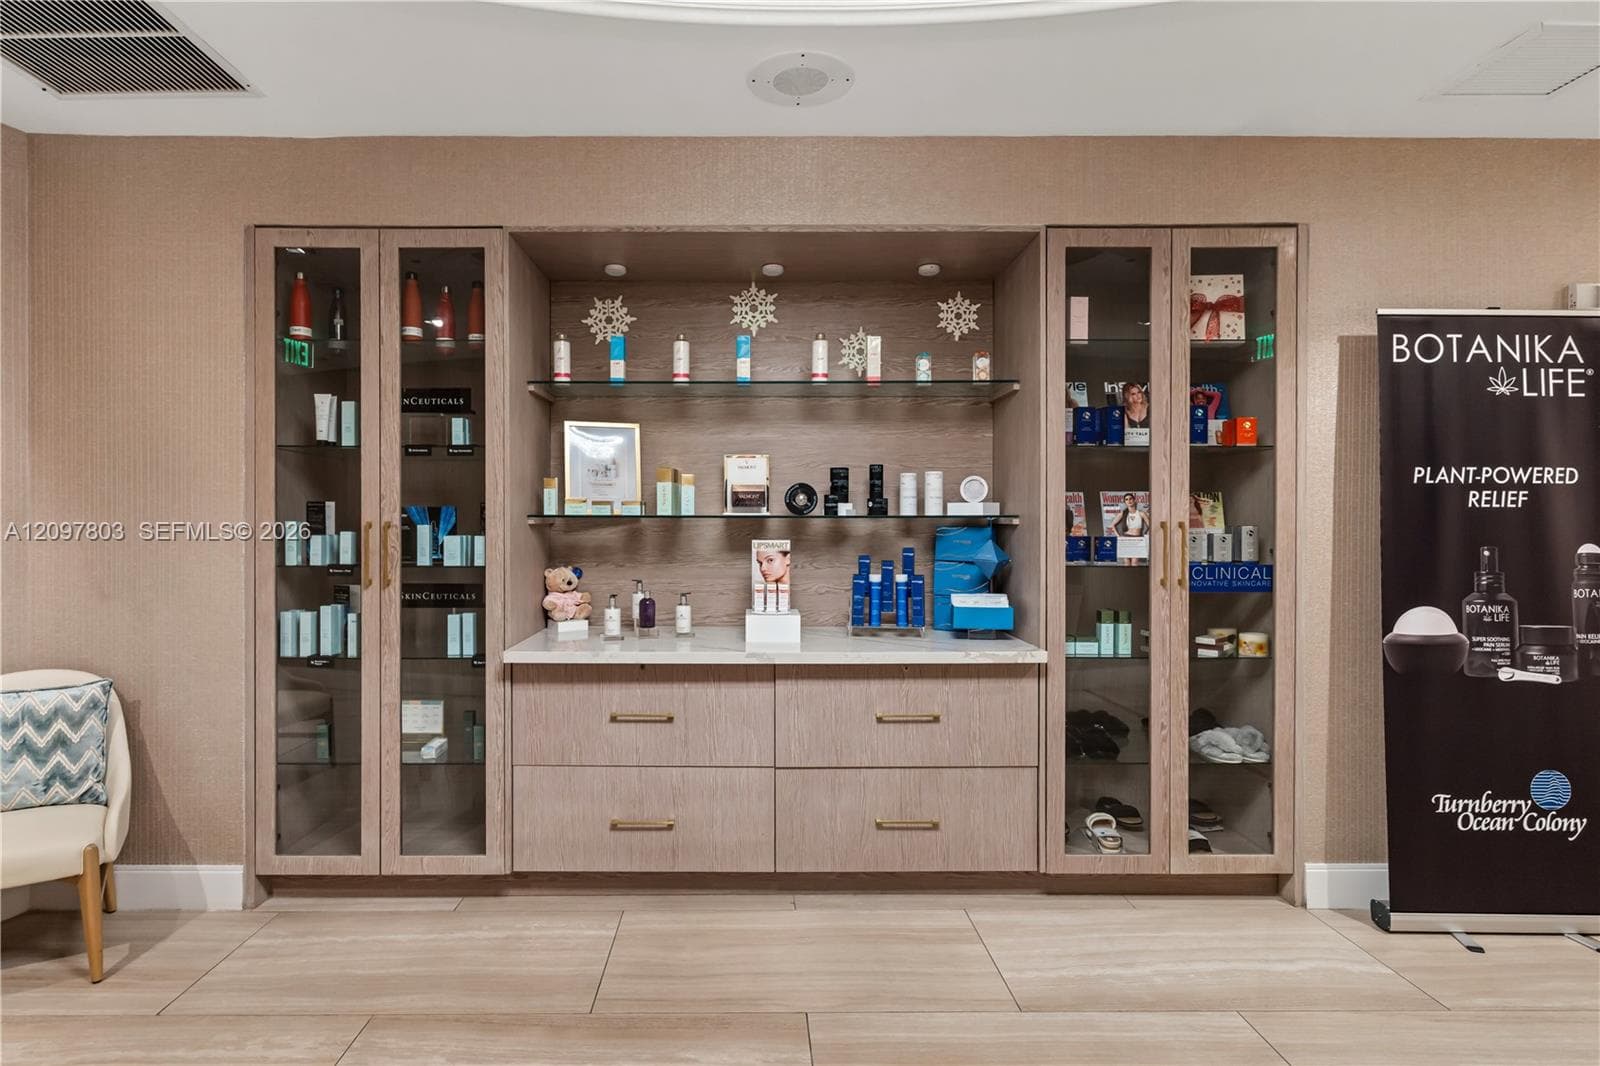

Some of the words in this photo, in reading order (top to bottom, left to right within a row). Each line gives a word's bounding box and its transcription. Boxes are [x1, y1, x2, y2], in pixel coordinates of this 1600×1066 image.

[1392, 333, 1585, 364] BOTANIKA
[1413, 466, 1579, 485] PLANT-POWERED
[1468, 490, 1529, 508] RELIEF
[1191, 566, 1273, 580] CLINICAL
[1573, 588, 1600, 599] BOTA
[1465, 604, 1510, 614] BOTANIKA
[1493, 613, 1510, 623] LIFE
[1431, 790, 1531, 821] Turnberry
[1457, 812, 1514, 831] Ocean
[1523, 811, 1587, 841] Colony
